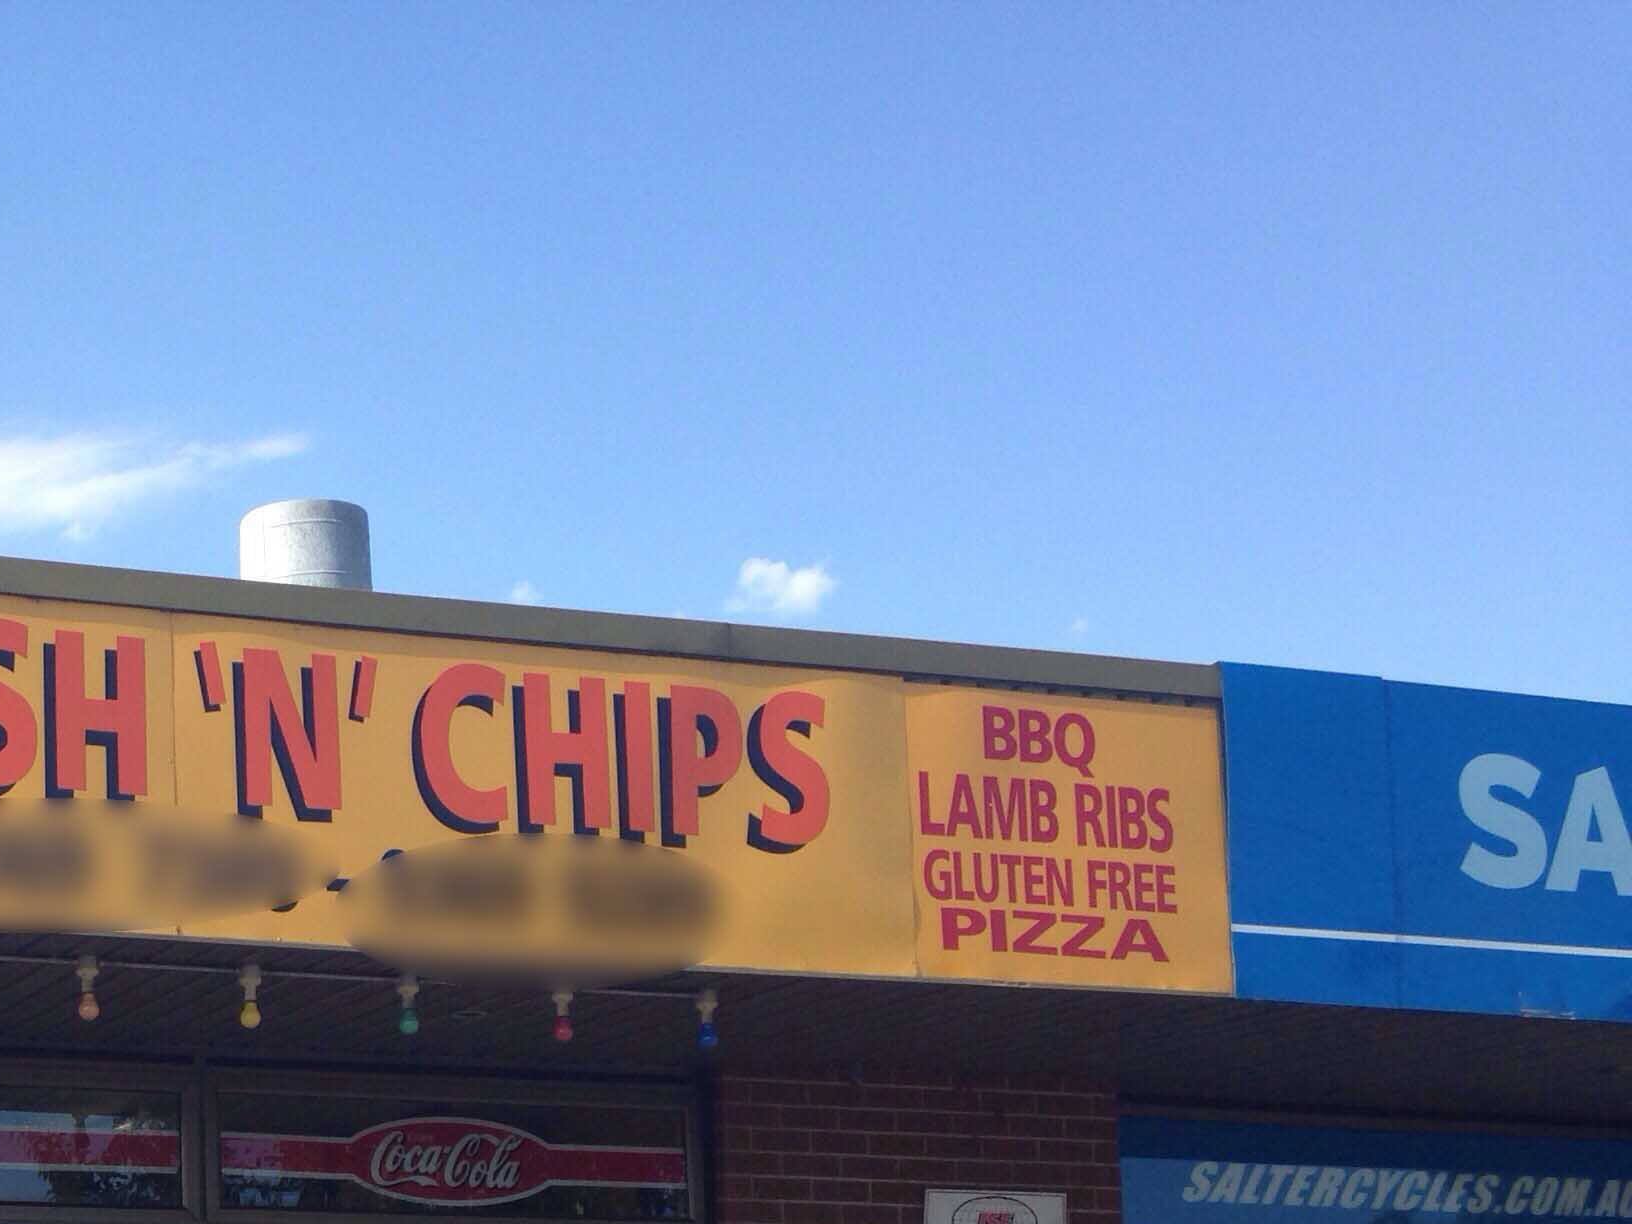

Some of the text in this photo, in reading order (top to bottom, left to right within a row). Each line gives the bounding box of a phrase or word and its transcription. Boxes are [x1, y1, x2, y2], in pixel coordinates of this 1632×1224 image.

[194, 640, 378, 823] 'N'
[411, 662, 830, 854] CHIPS
[982, 705, 1096, 778] BBQ
[918, 771, 1174, 853] LAMB RIBS
[1458, 752, 1632, 897] SA
[923, 849, 1178, 914] GLUTEN FREE
[940, 907, 1170, 963] PIZZA
[370, 1130, 524, 1190] Coca-Cola
